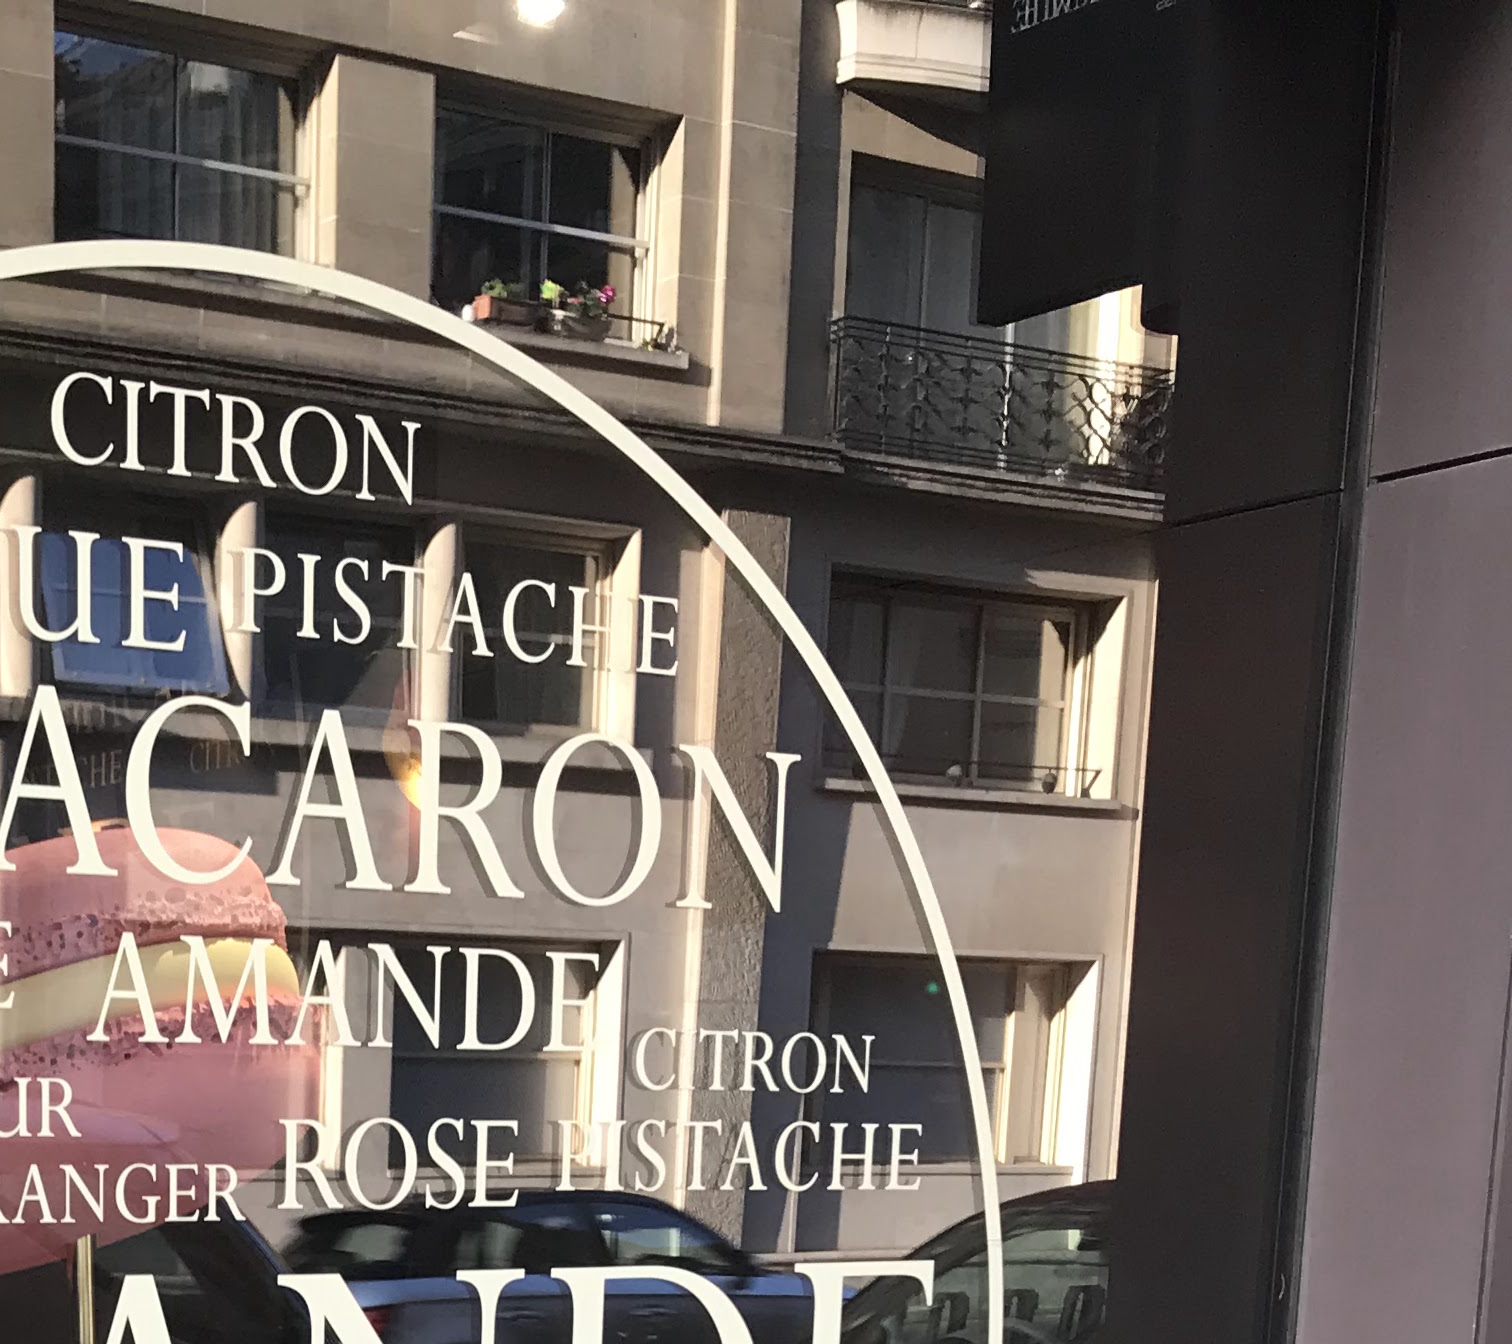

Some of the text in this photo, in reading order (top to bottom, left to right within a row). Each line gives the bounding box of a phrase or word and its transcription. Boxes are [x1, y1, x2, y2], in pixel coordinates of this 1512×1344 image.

[50, 371, 422, 505] CITRON
[225, 546, 679, 676] PISTACHE
[86, 930, 601, 1052] AMANDE
[635, 1026, 876, 1094] CITRON
[277, 1116, 520, 1211] ROSE
[554, 1118, 925, 1193] PISTACHE
